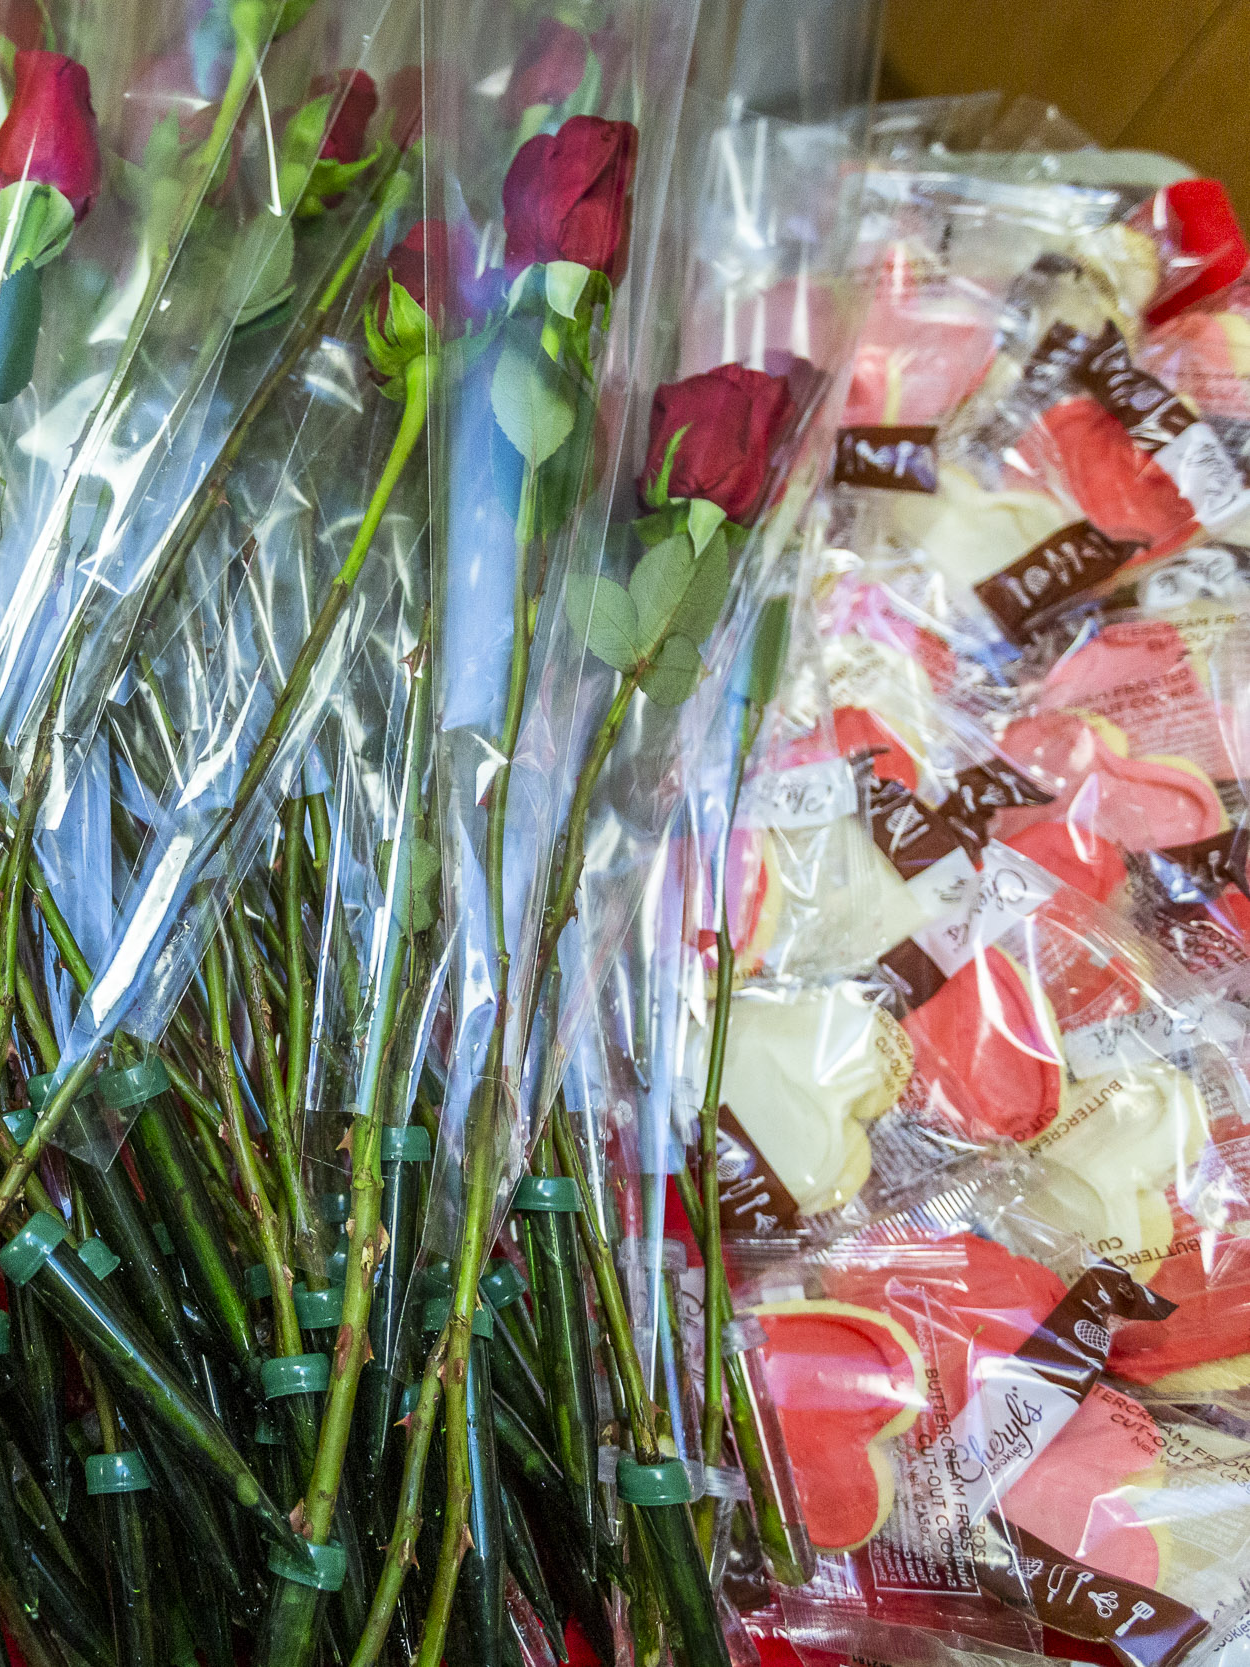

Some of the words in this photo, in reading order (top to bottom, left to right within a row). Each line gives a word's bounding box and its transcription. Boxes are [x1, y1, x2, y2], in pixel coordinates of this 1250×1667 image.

[925, 1368, 967, 1498] BUTTERCREAM
[988, 1441, 1027, 1476] cookies
[1110, 1413, 1195, 1464] CUT-OUT
[1131, 1435, 1157, 1457] Net
[918, 1433, 947, 1509] CUT-OUT
